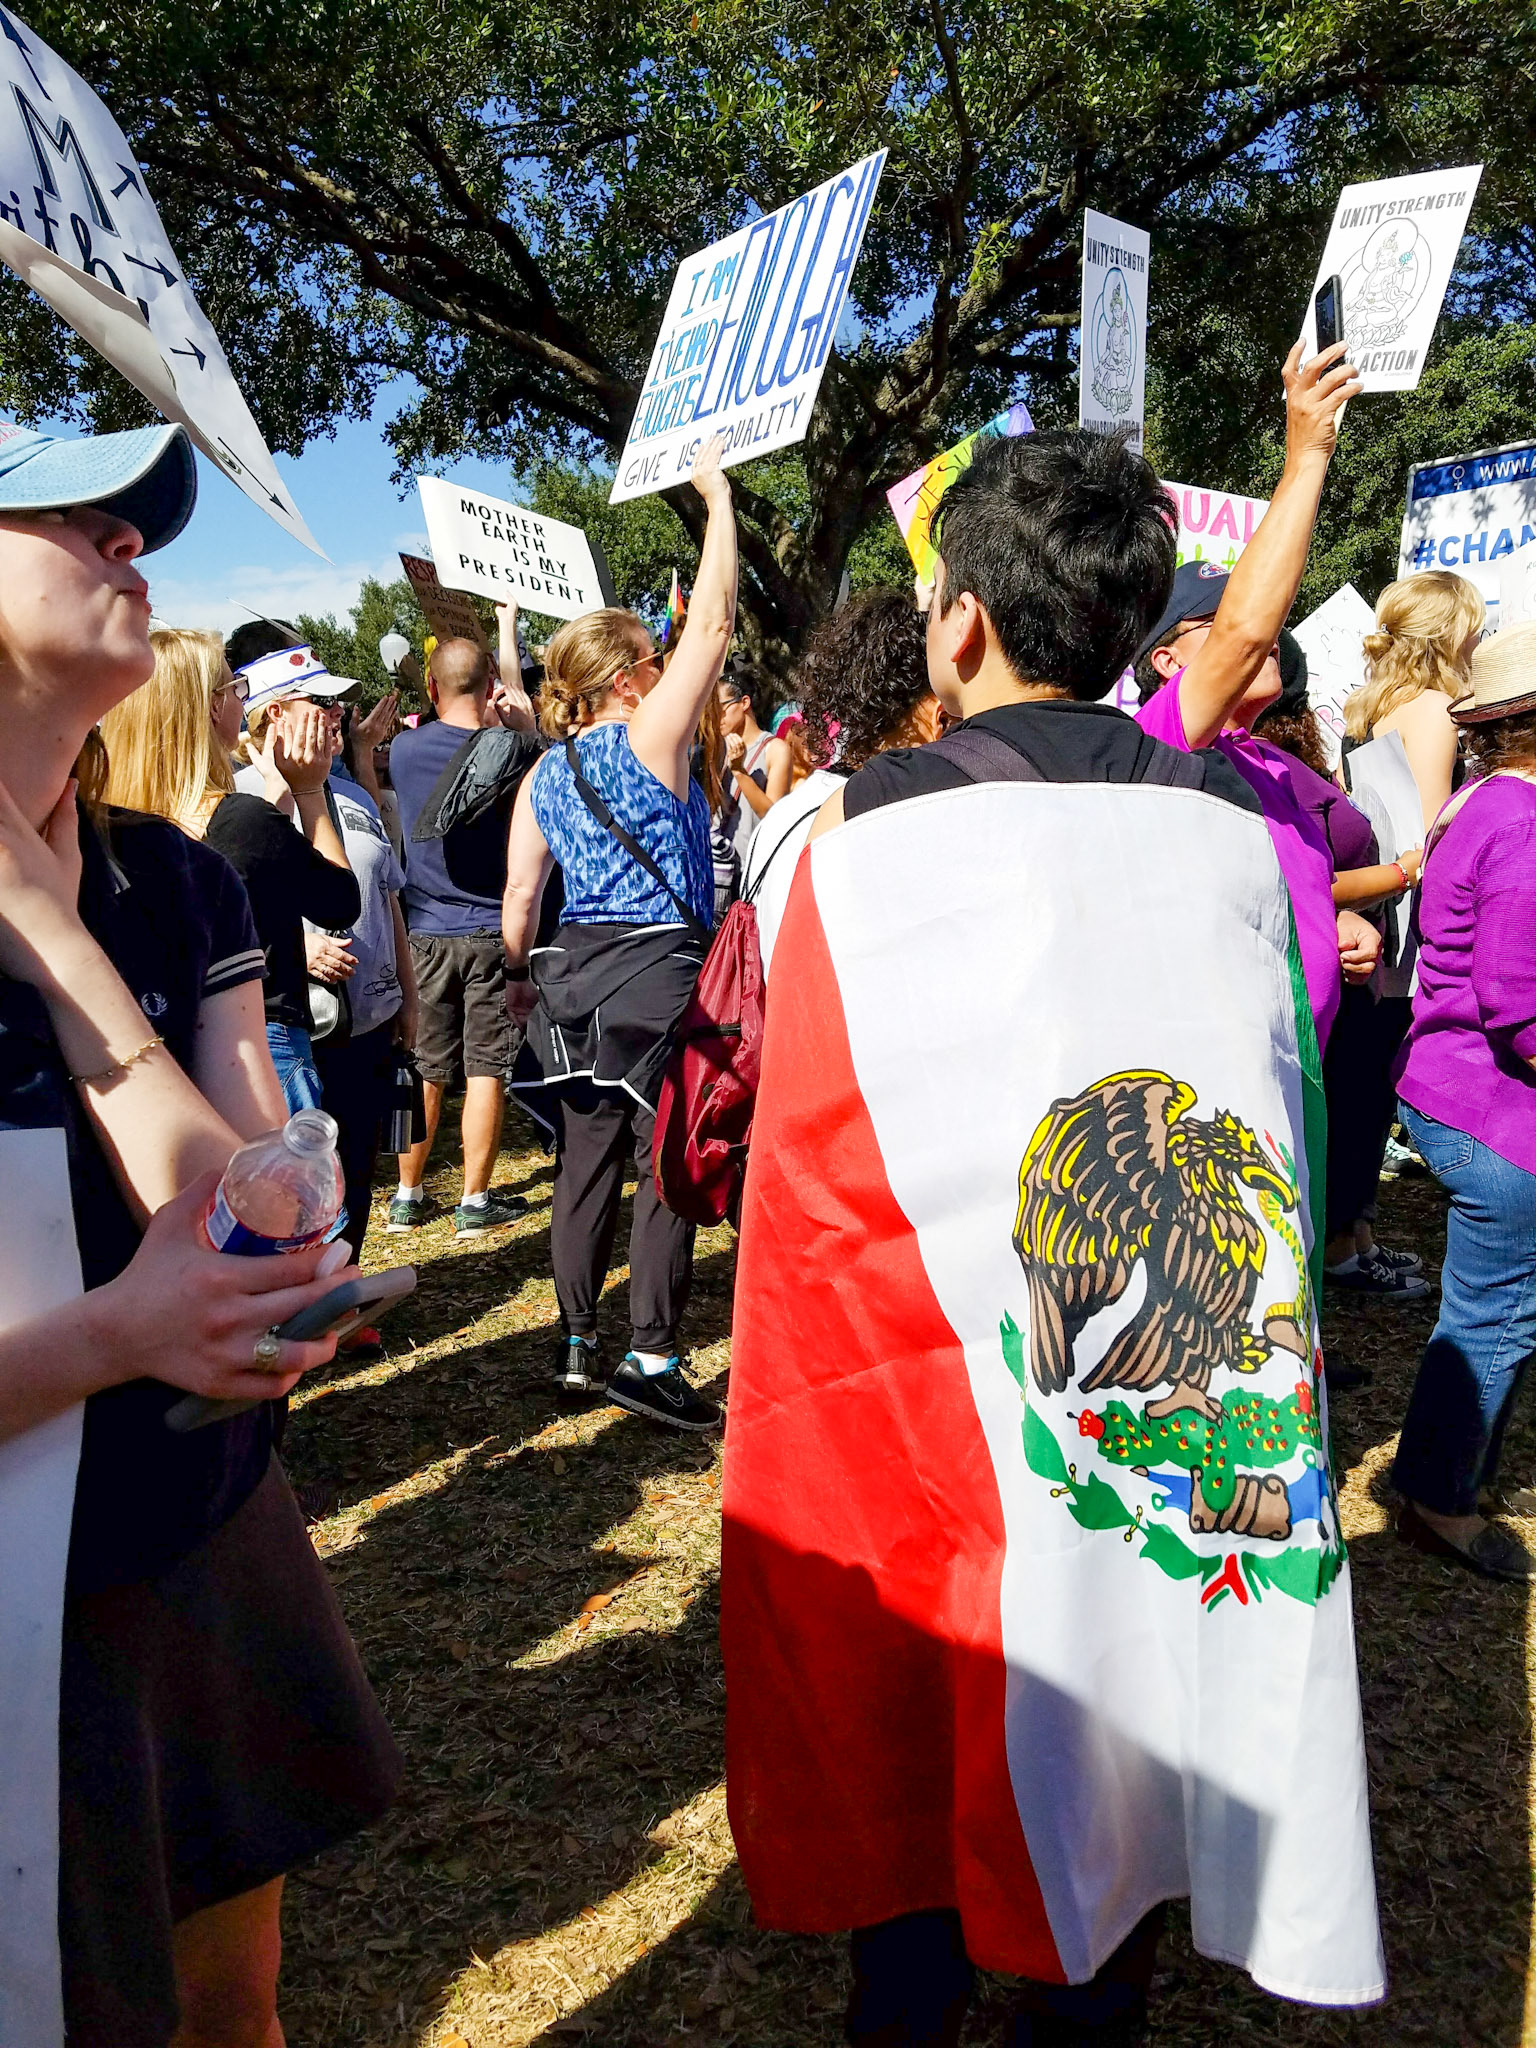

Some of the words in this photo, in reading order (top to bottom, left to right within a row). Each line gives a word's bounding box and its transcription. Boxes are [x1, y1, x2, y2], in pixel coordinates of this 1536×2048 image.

[1339, 205, 1386, 230] UNITY
[1386, 190, 1467, 216] STRENGTH
[0, 185, 127, 297] ith
[1087, 237, 1109, 269] UNITY
[681, 268, 706, 318] I
[701, 251, 741, 307] AM
[1359, 348, 1419, 373] ACTION
[623, 450, 668, 488] GIVE
[460, 498, 546, 538] MOTHER
[481, 521, 546, 553] EARTH
[458, 553, 584, 604] PRESIDENT
[512, 548, 530, 566] IS
[538, 556, 567, 577] MY
